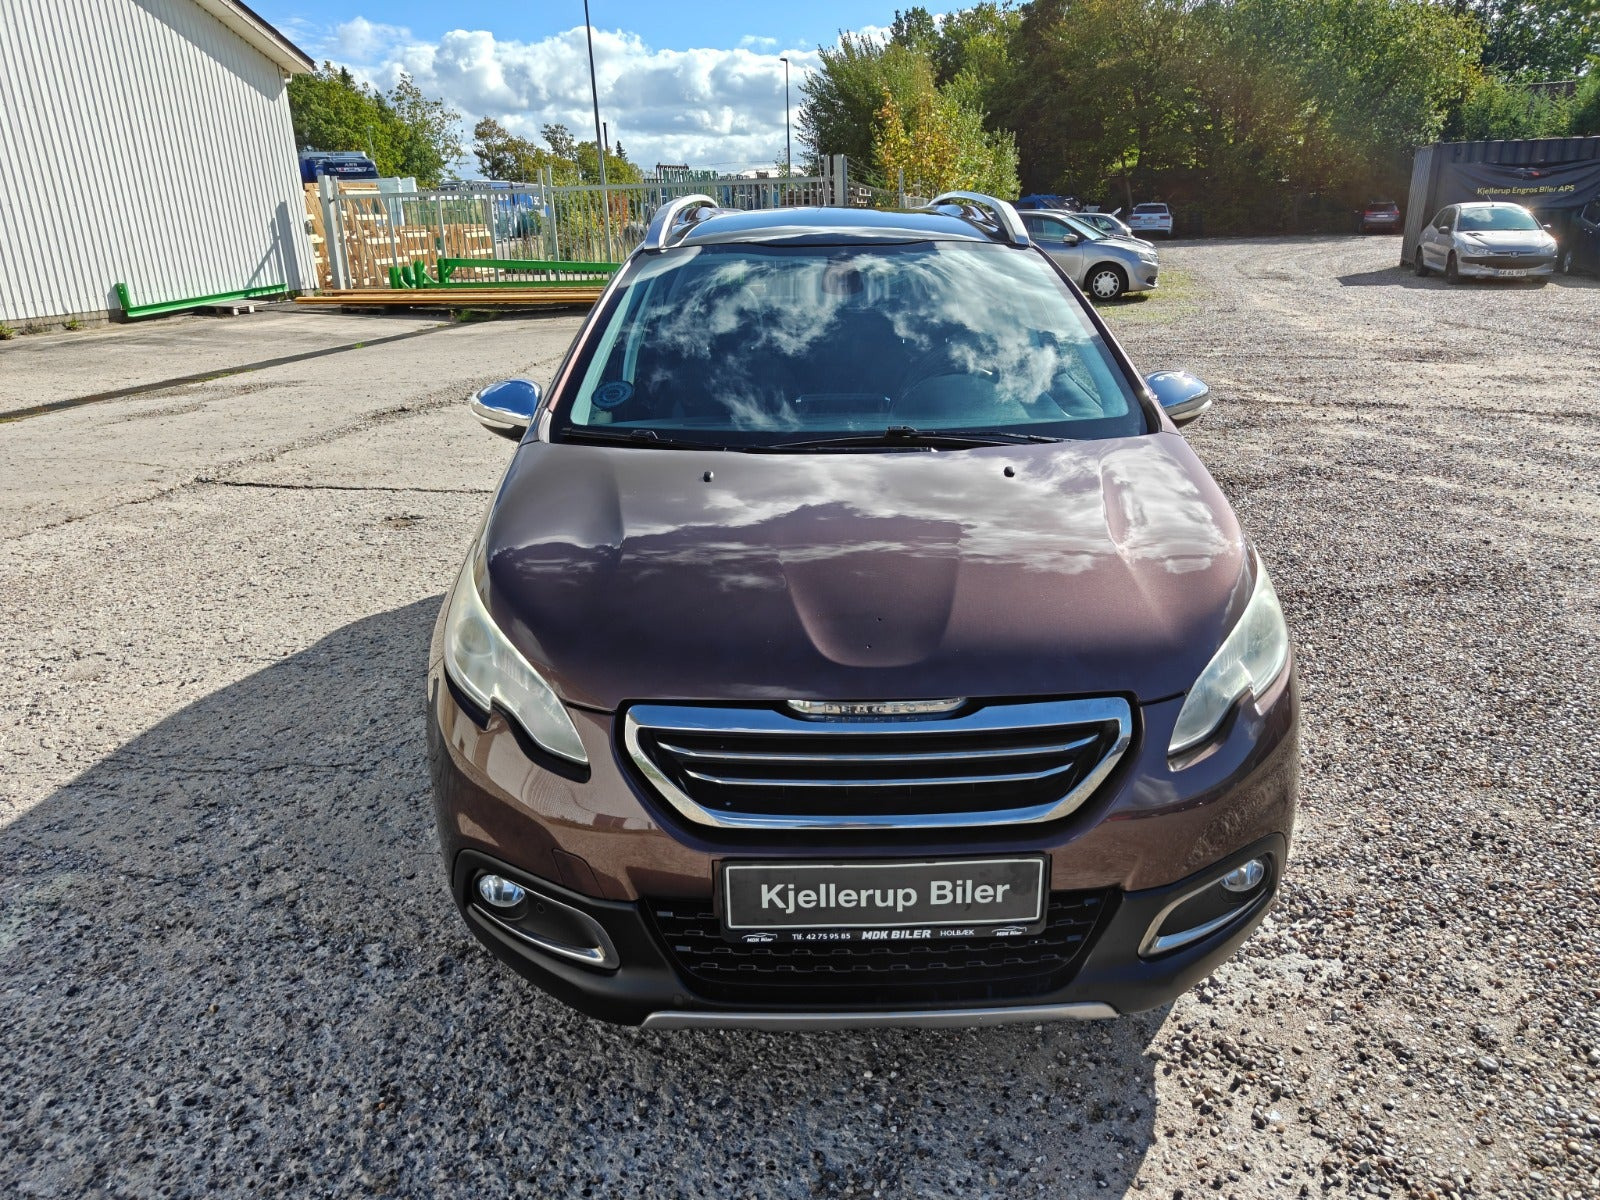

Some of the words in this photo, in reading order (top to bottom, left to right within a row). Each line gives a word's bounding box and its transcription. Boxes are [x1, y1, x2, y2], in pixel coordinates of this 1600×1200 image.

[1477, 187, 1511, 195] Kjellerup
[1512, 186, 1538, 195] Engros
[1539, 185, 1557, 193] Biler
[1558, 184, 1575, 192] APS
[761, 882, 918, 914] Kjellerup
[930, 879, 1010, 906] Biler
[841, 932, 851, 940] 85
[862, 930, 889, 940] MDK
[891, 929, 932, 939] BILER
[940, 929, 975, 937] HOLBÆK
